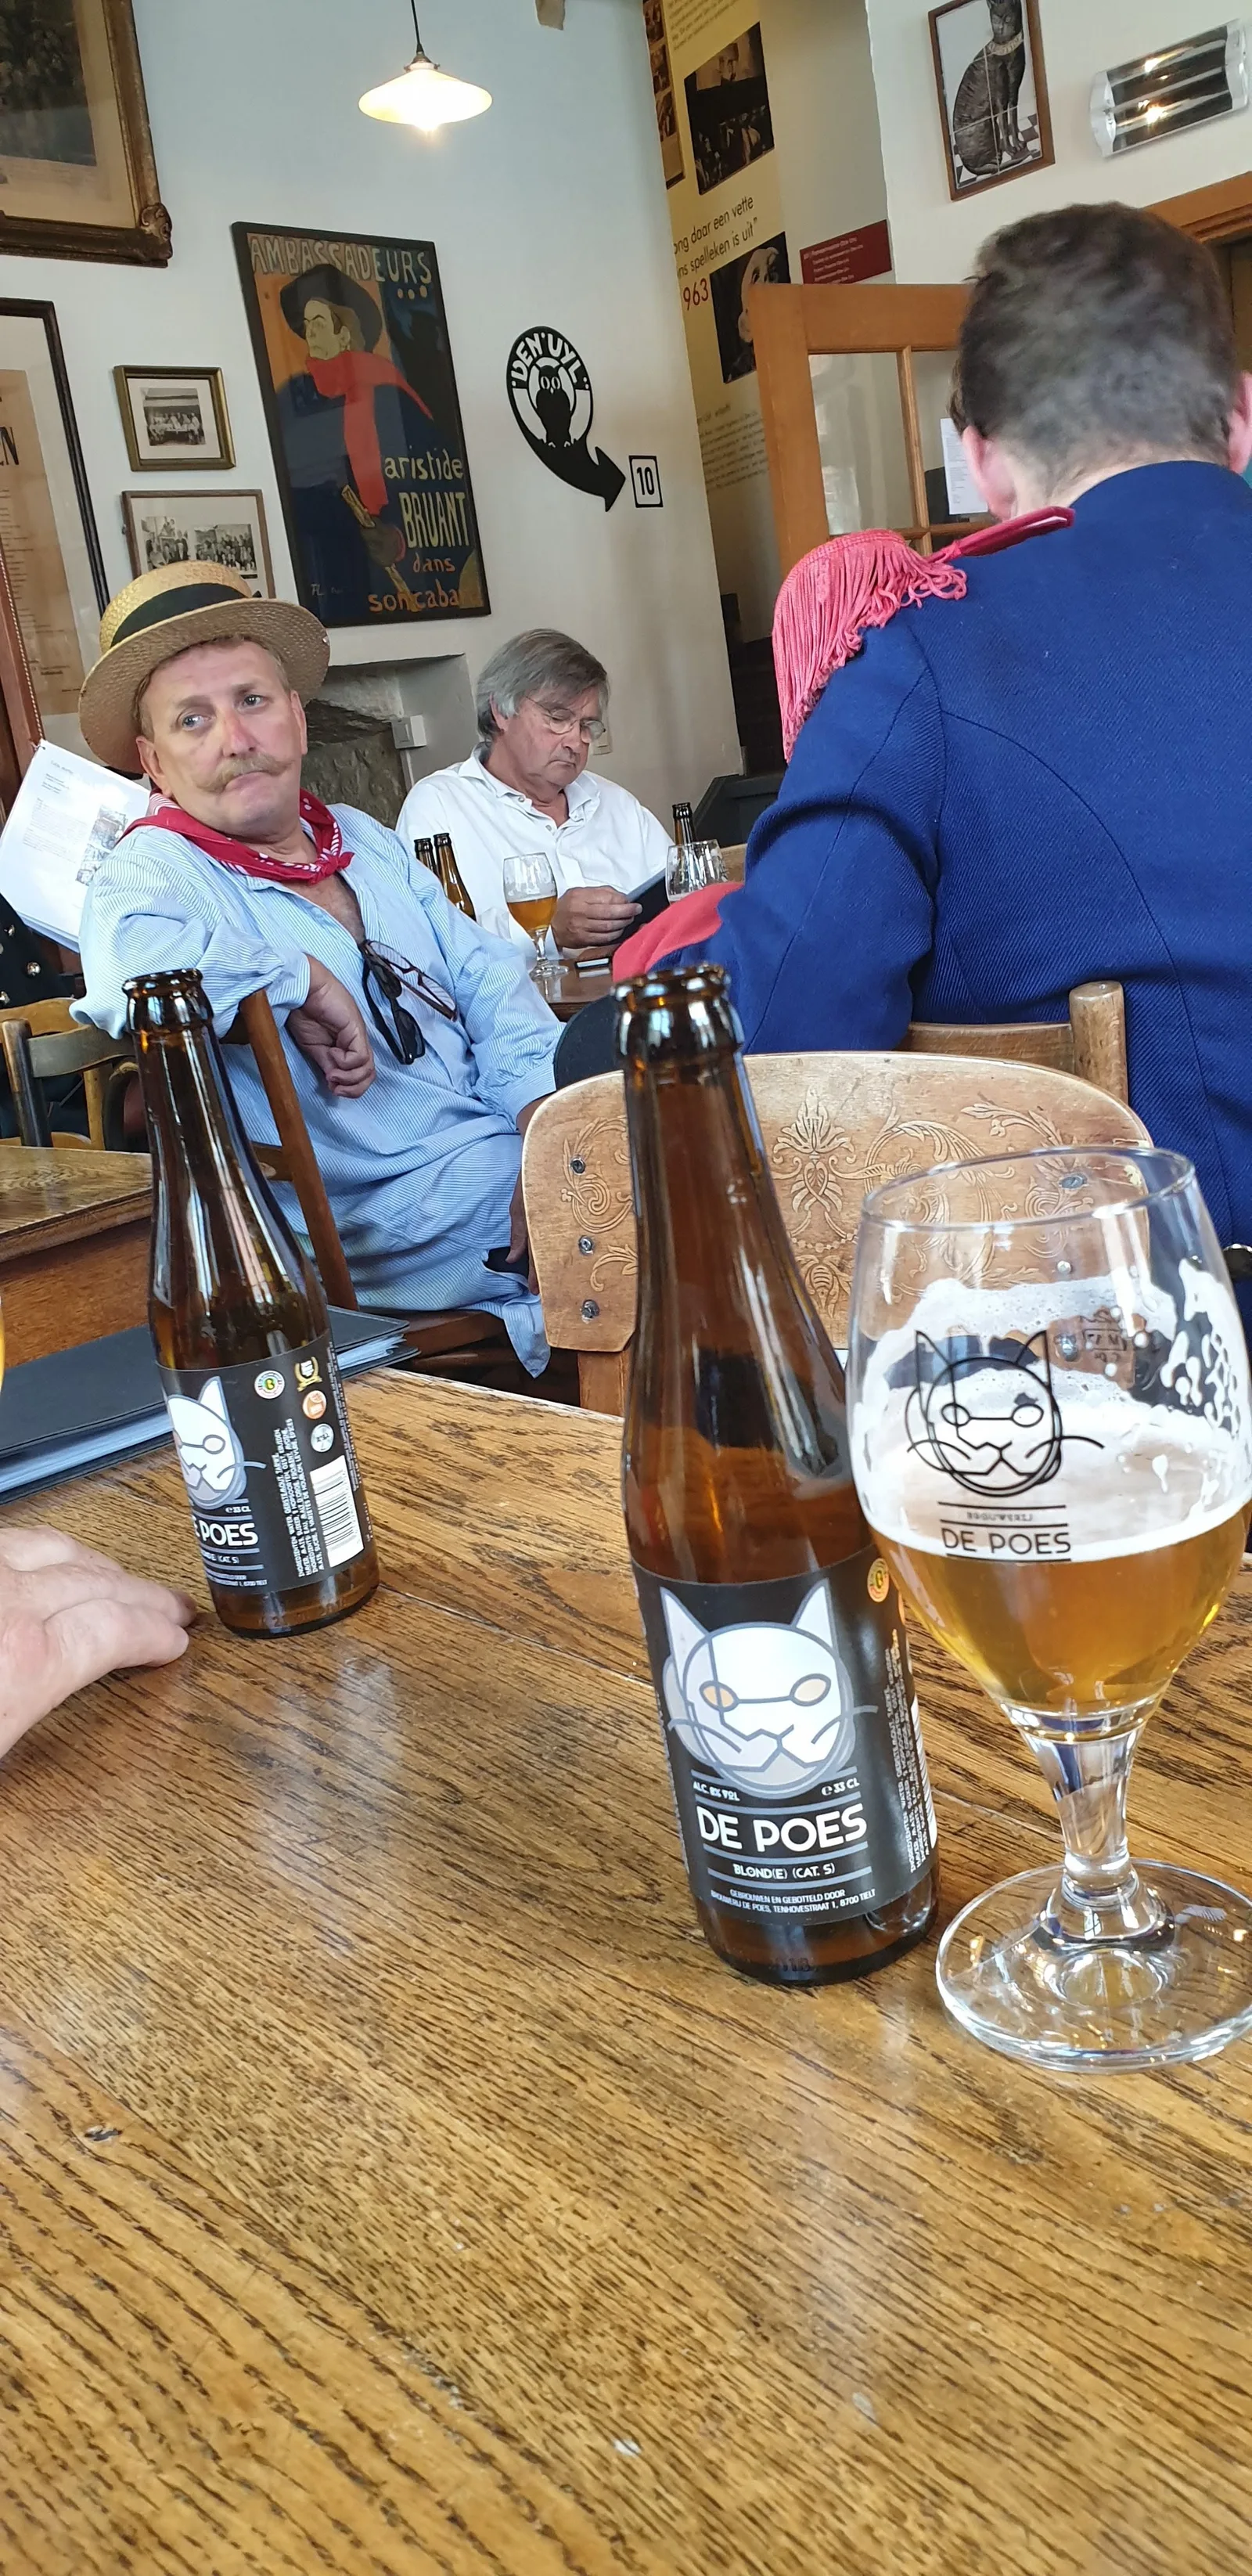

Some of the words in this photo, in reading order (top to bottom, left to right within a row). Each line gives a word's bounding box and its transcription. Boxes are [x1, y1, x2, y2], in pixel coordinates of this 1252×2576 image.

[691, 222, 711, 243] daar
[714, 211, 729, 230] een
[732, 196, 754, 218] vette
[691, 240, 730, 273] spelleken
[732, 230, 740, 248] is
[547, 333, 581, 384] UYL
[384, 448, 464, 480] aristide
[636, 467, 656, 495] 10
[398, 491, 470, 548] BRUANT
[413, 552, 456, 573] dans
[368, 591, 410, 612] son
[199, 1519, 259, 1547] POES
[941, 1527, 977, 1553] DE
[988, 1532, 1071, 1555] POES
[833, 1781, 846, 1793] 33
[846, 1778, 860, 1789] CL
[696, 1805, 743, 1850] DE
[753, 1803, 868, 1853] POES
[732, 1863, 788, 1879] BLOND(E)
[793, 1866, 820, 1879] (CAT.
[729, 1889, 771, 1904] GEBROUWEN
[771, 1896, 782, 1904] EN
[782, 1893, 824, 1904] GEBOTTELD
[824, 1889, 846, 1900] DOOR
[742, 1901, 752, 1910] DE
[772, 1902, 829, 1914] TENHOVESTRAAT
[840, 1895, 859, 1908] 8700
[859, 1888, 876, 1902] TIELT
